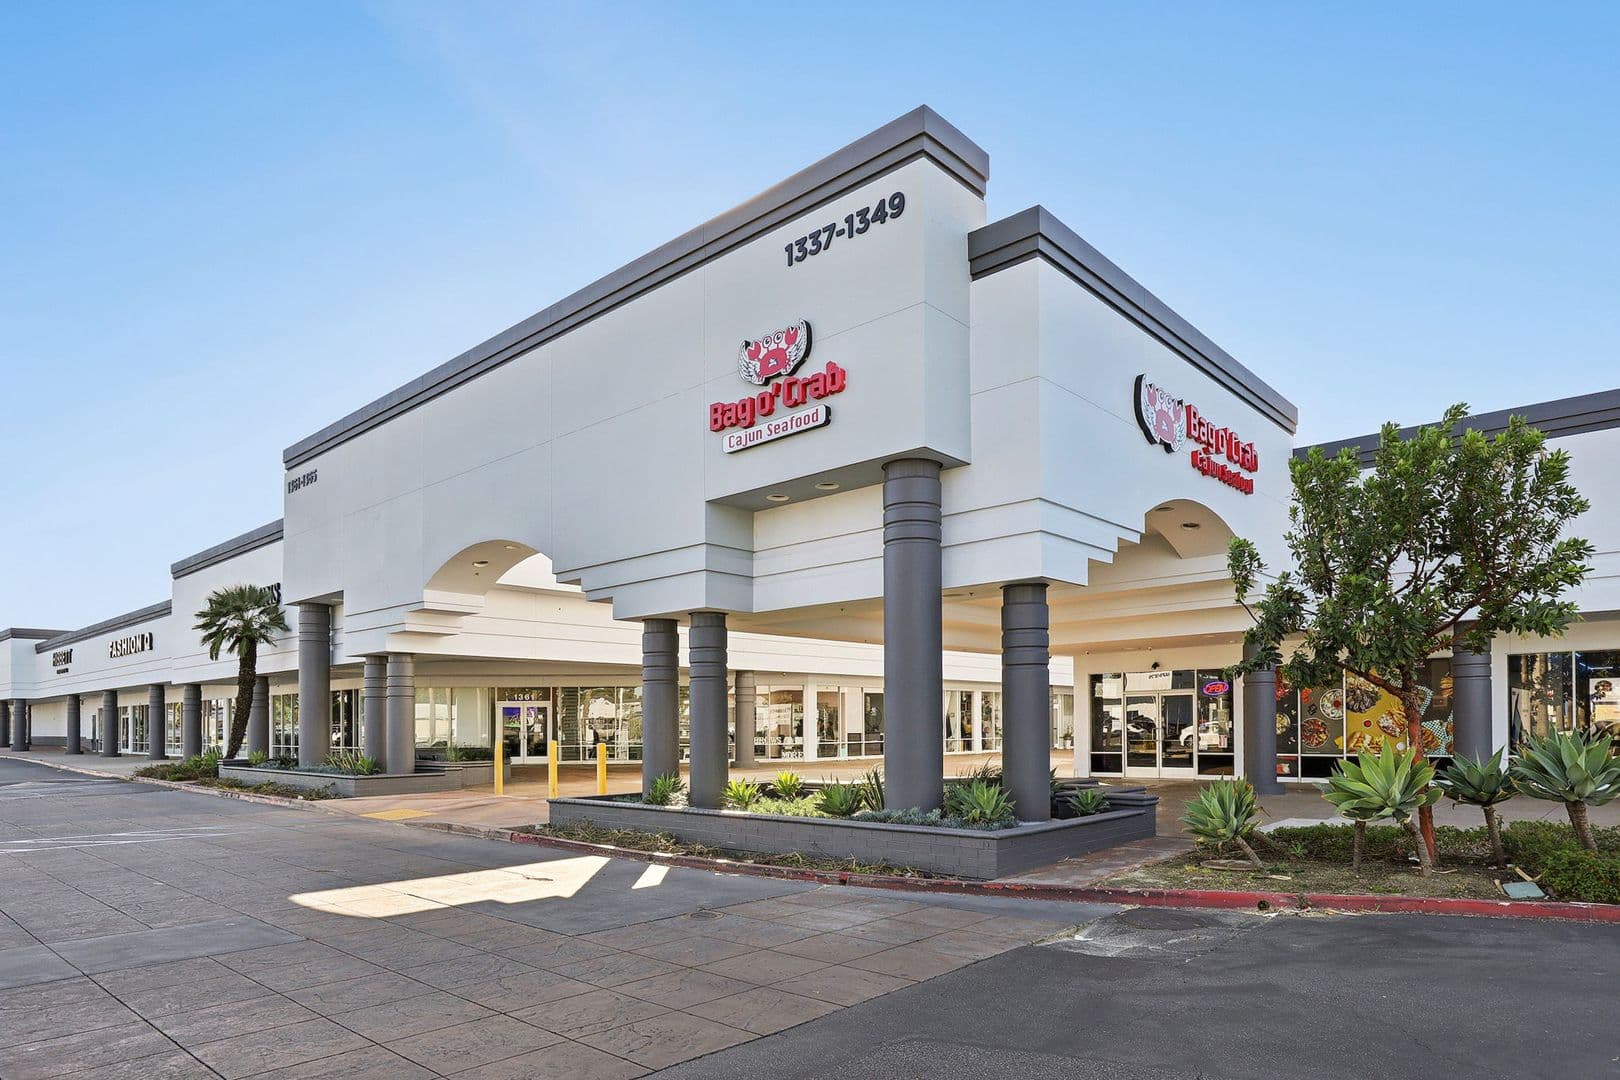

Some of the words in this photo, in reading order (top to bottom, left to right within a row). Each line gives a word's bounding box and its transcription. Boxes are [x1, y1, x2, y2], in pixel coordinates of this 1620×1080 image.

[785, 191, 905, 267] 1337-1349
[709, 397, 756, 432] Bag
[757, 382, 781, 417] o'
[782, 360, 846, 408] Crab
[728, 427, 763, 449] Cajun
[766, 408, 819, 437] Seafood
[1185, 404, 1215, 455] Bag
[1226, 431, 1258, 473] Crab
[109, 634, 144, 658] FASHION
